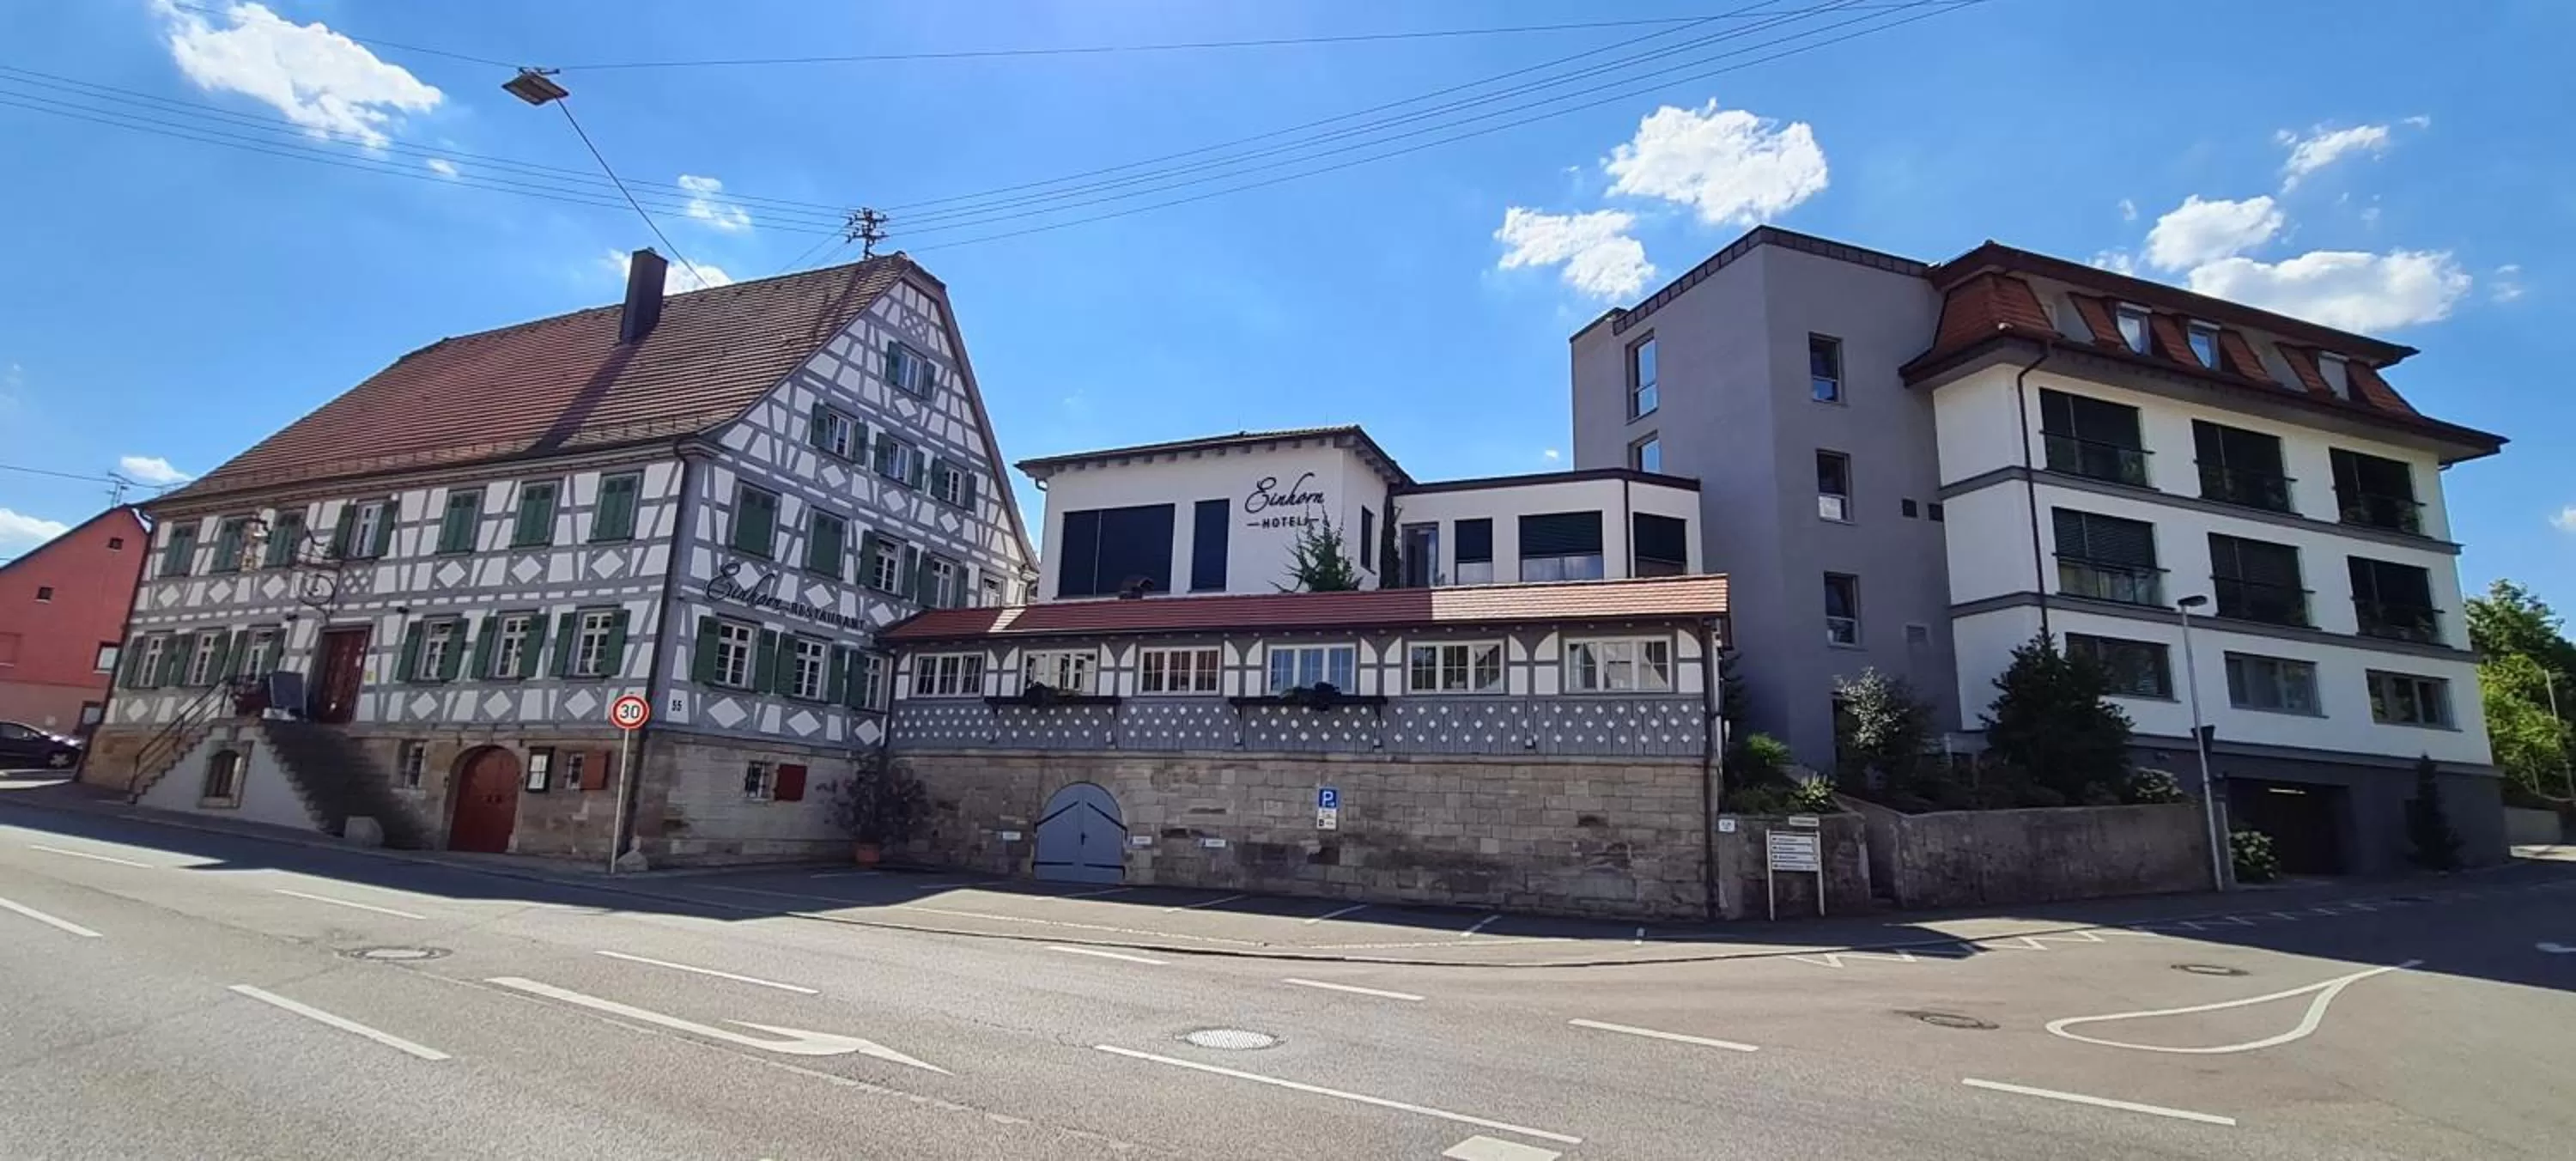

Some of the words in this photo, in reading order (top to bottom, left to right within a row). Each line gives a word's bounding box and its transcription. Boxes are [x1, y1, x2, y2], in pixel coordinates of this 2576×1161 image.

[1245, 472, 1325, 514] Einhorn
[707, 562, 782, 606] Einhorn
[791, 602, 866, 630] RESTAURANT
[620, 704, 641, 719] 30
[671, 700, 683, 712] 55
[1323, 791, 1334, 808] P
